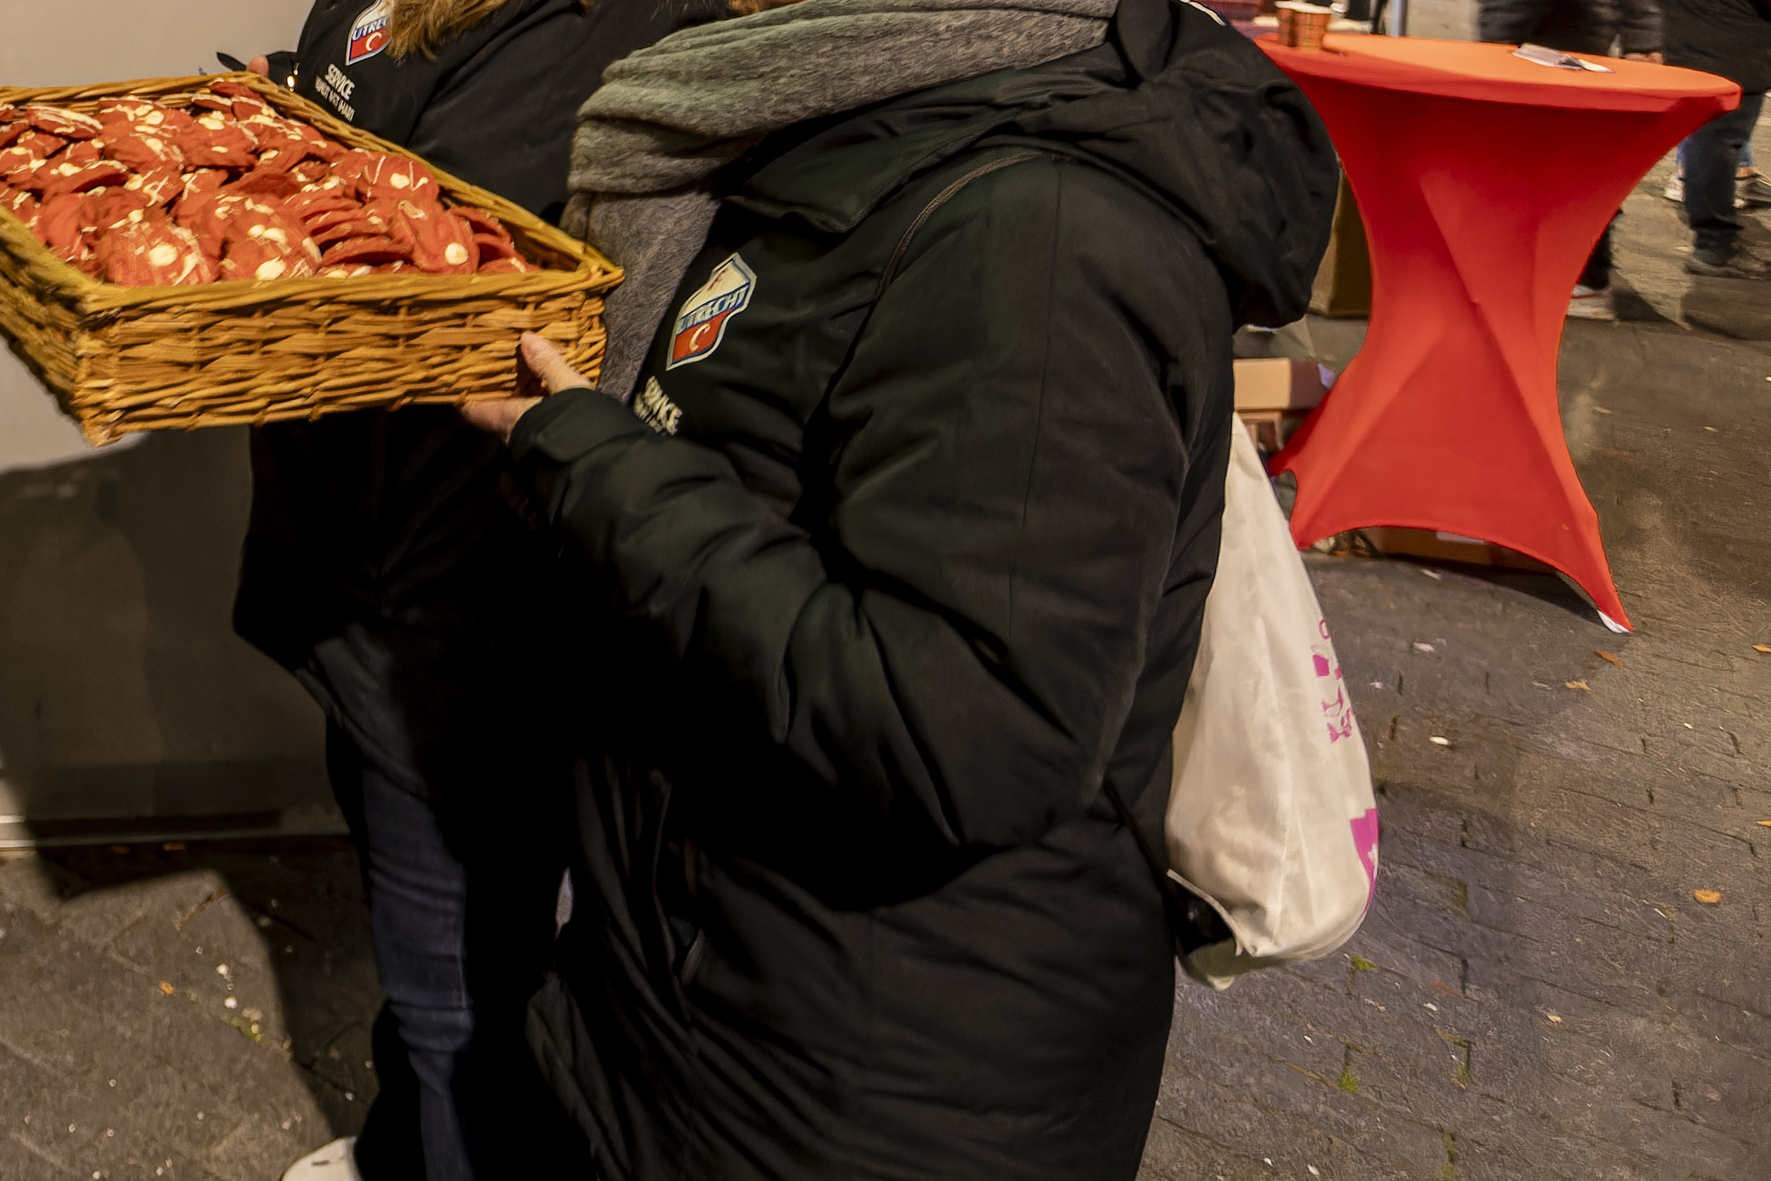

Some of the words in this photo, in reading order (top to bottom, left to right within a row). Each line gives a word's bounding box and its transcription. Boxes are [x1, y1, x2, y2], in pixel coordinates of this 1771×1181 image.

[353, 18, 389, 41] UTRE
[365, 32, 382, 51] C
[324, 63, 356, 101] SERVICE
[676, 285, 749, 335] UTRECHT
[689, 323, 711, 352] C
